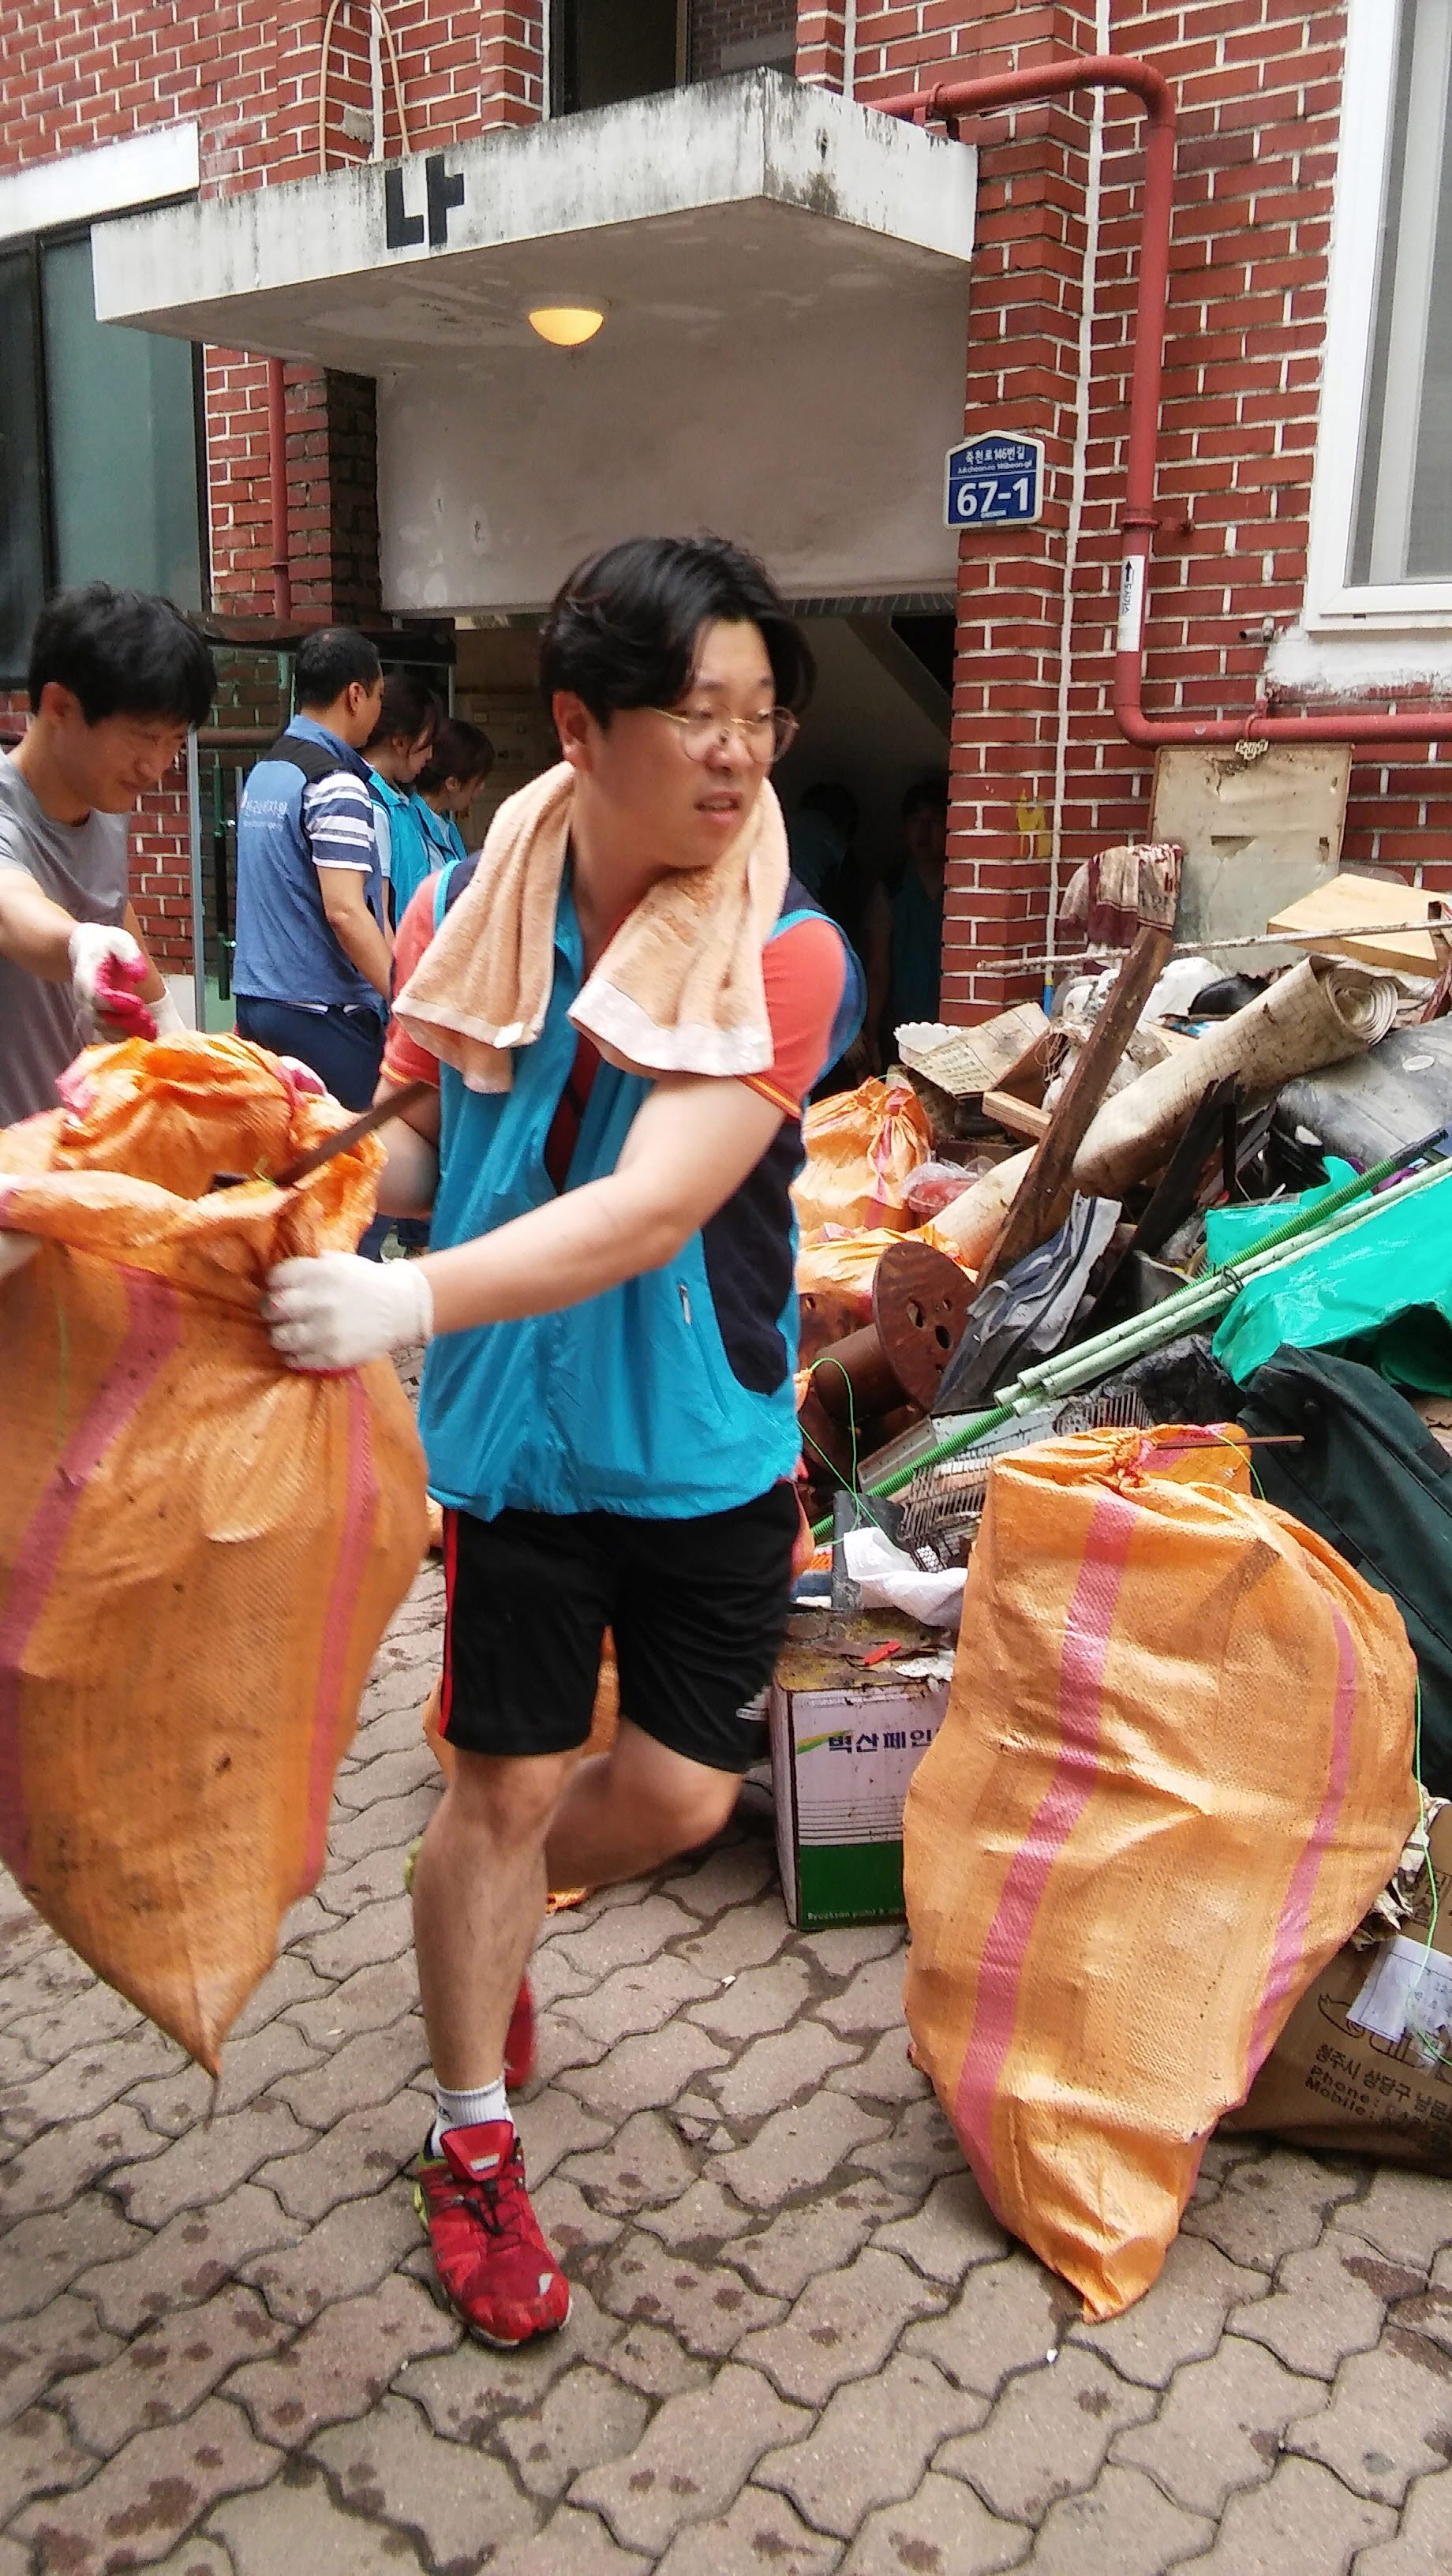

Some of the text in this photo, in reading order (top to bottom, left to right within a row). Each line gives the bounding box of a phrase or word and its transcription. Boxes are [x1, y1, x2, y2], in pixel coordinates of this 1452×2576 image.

[385, 154, 464, 249] 나
[956, 477, 1028, 517] 67-1
[1122, 583, 1132, 614] 도시가스
[829, 1728, 939, 1754] 벽산페인
[1315, 2044, 1362, 2080] 청주시
